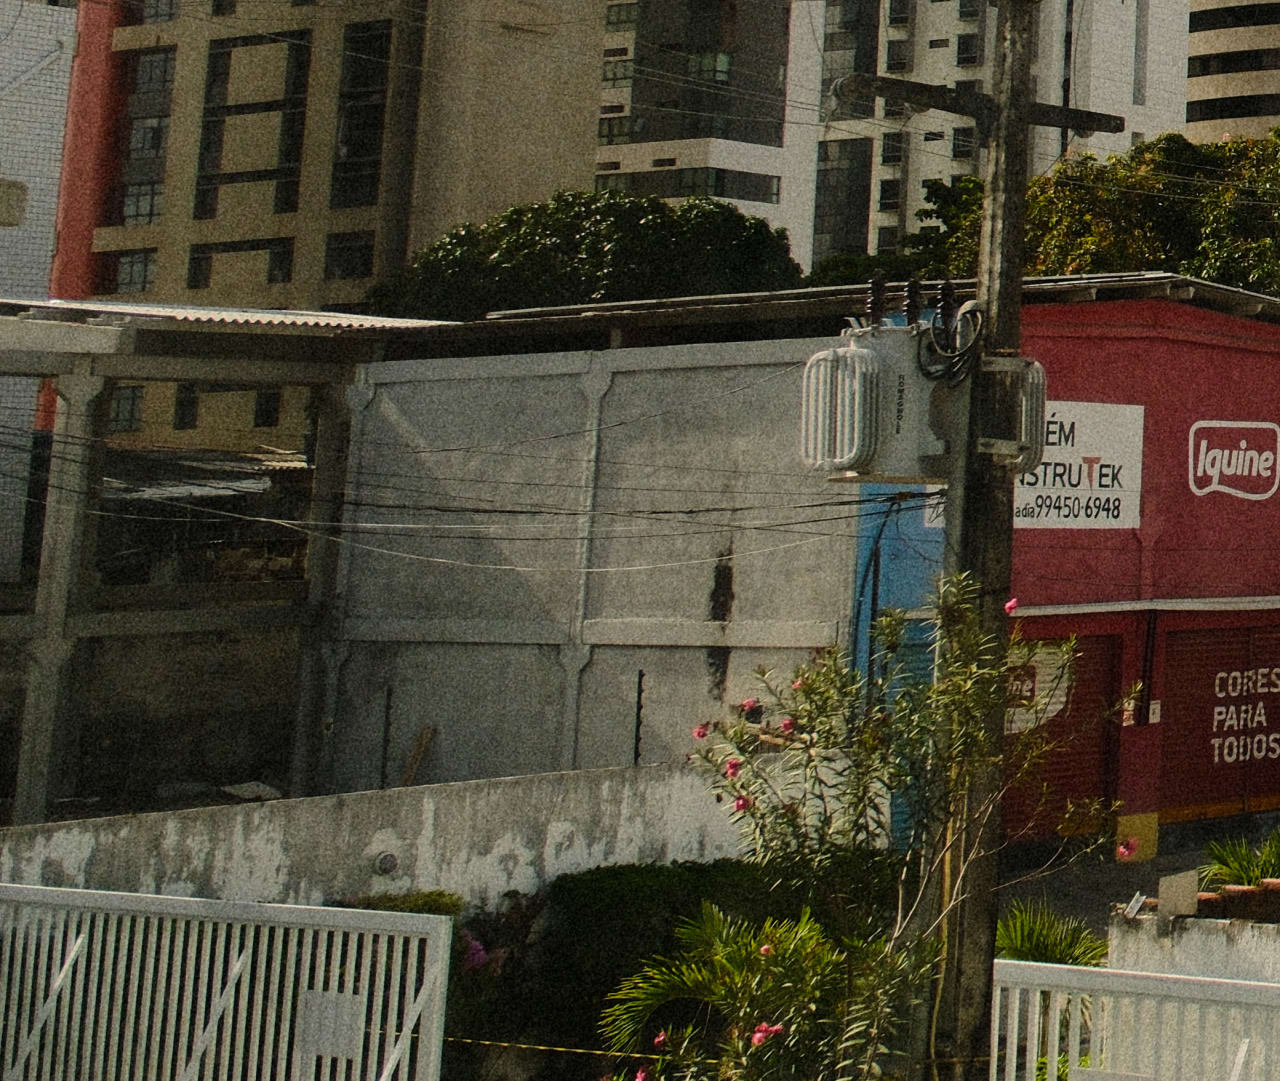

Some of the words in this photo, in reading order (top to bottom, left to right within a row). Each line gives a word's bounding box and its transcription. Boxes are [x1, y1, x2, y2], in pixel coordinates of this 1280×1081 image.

[1197, 439, 1274, 486] Iquine
[1213, 701, 1267, 732] PARA
[1211, 733, 1280, 763] TODOS
